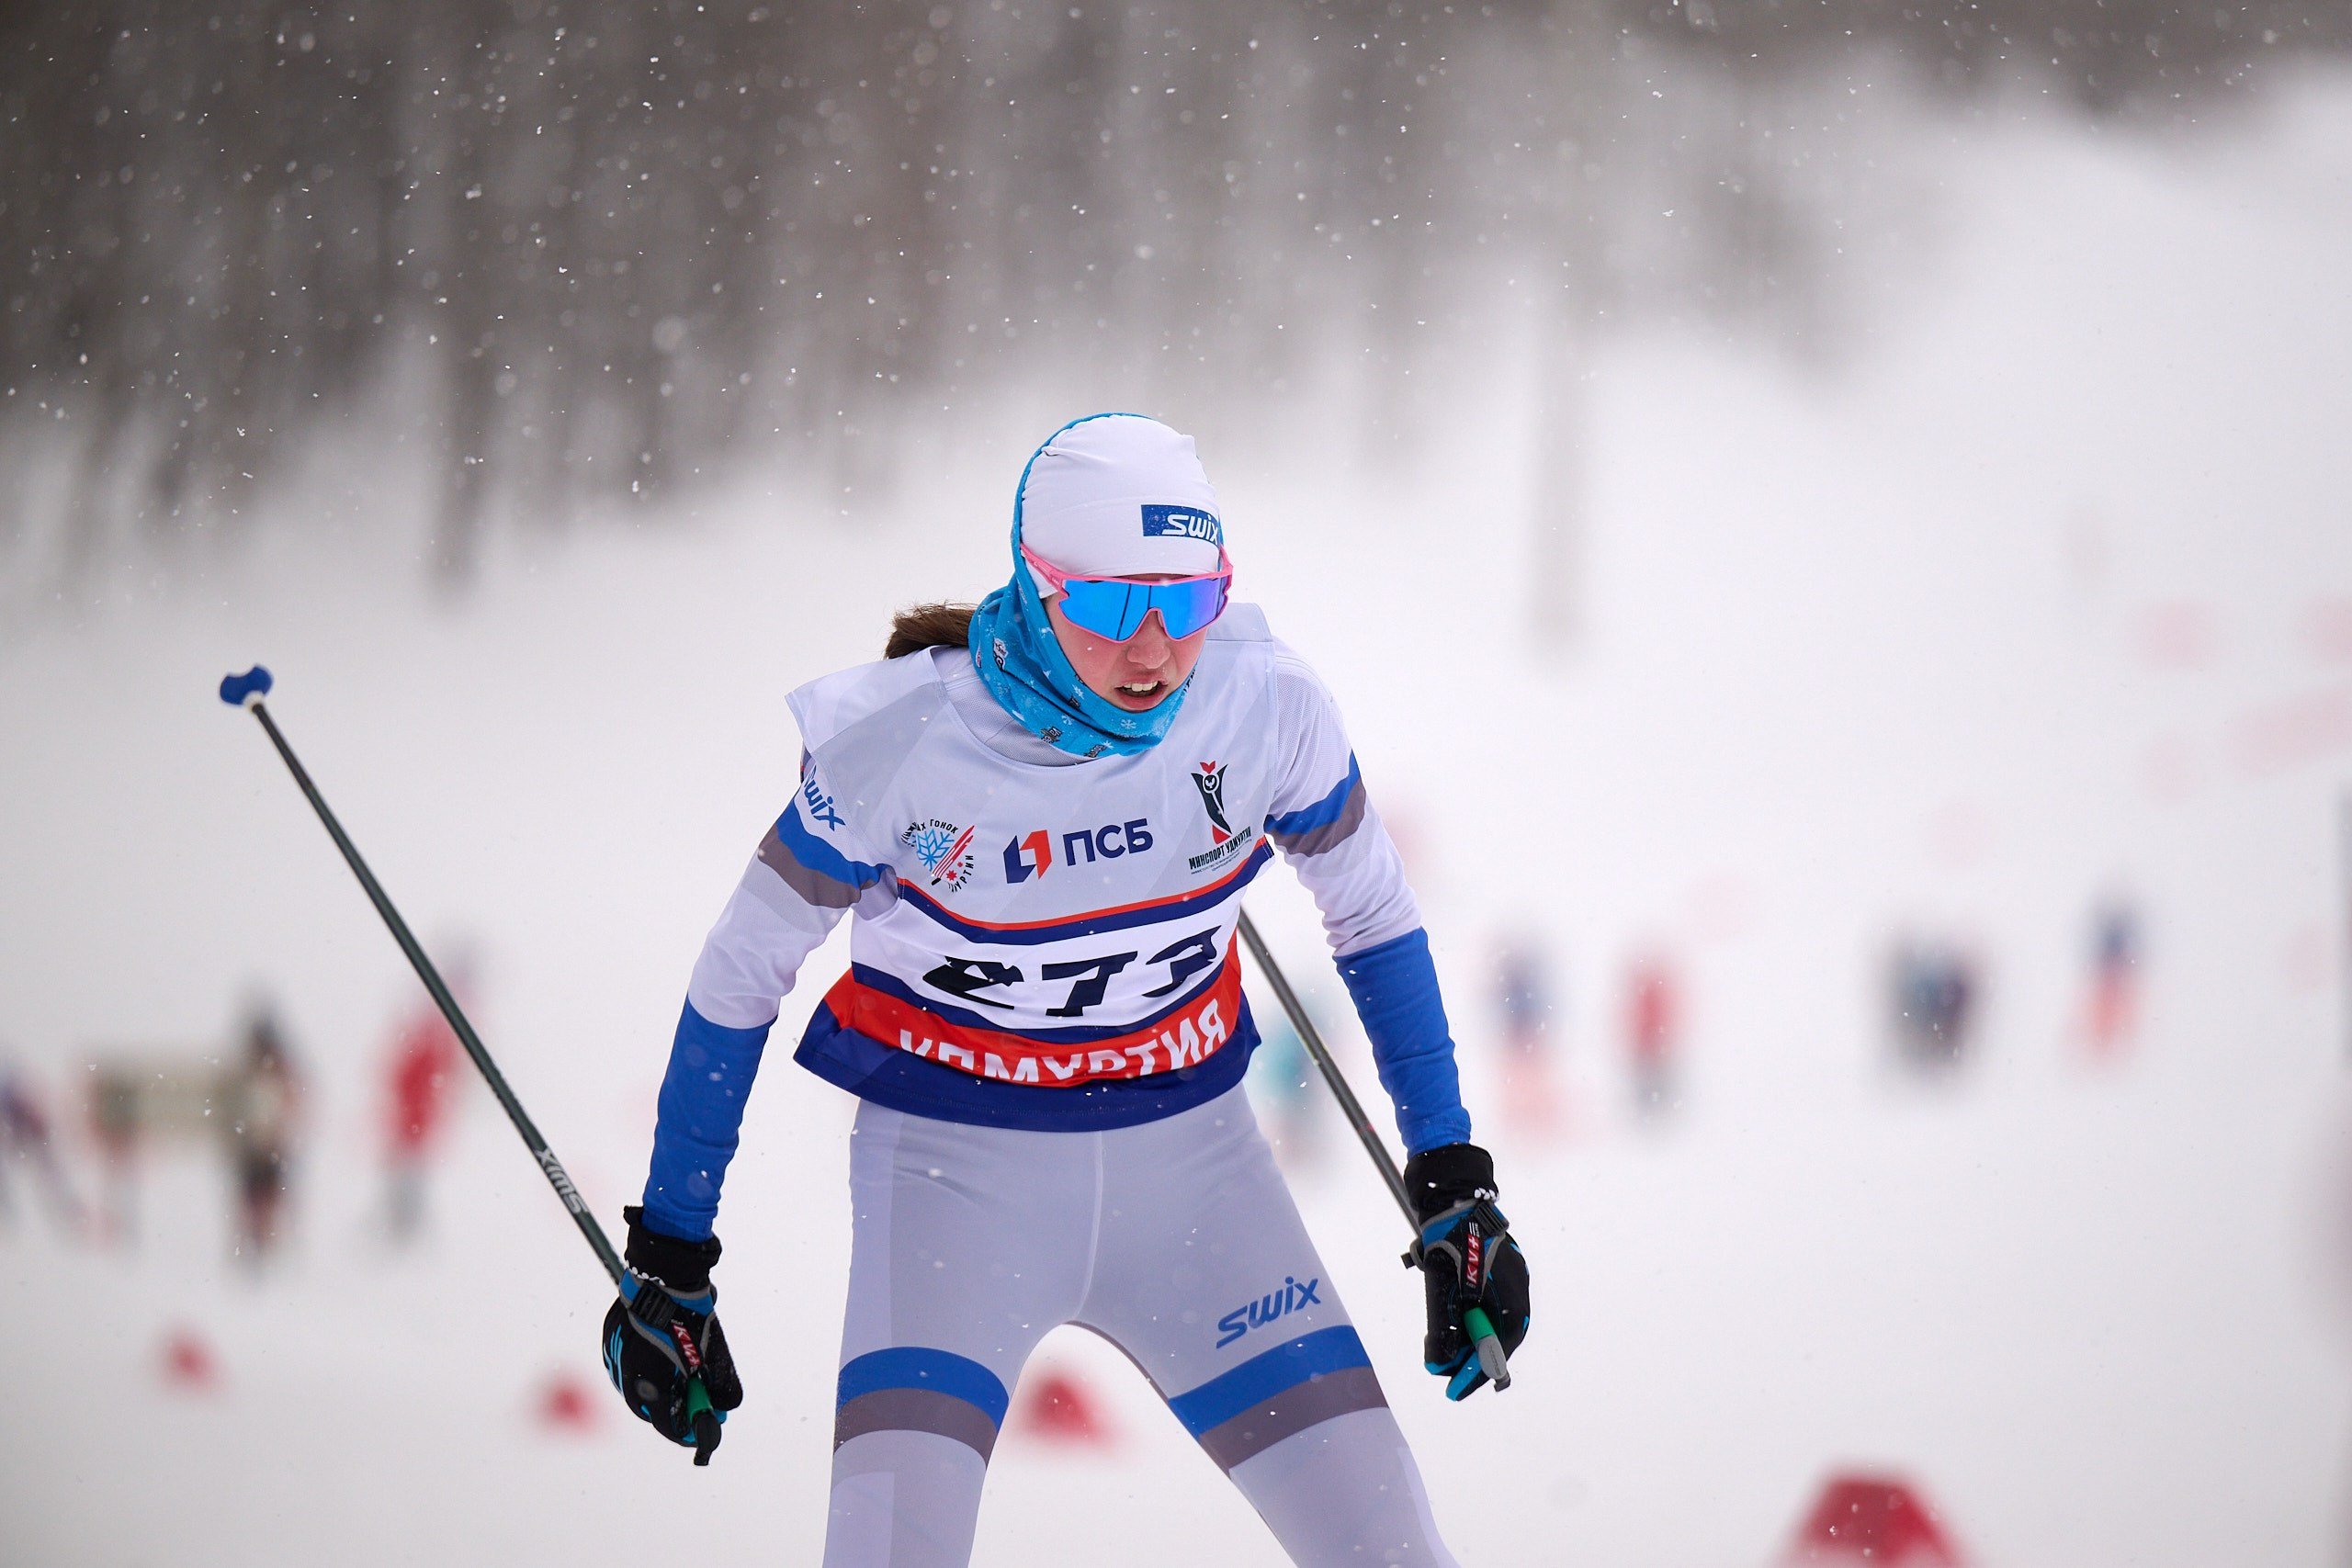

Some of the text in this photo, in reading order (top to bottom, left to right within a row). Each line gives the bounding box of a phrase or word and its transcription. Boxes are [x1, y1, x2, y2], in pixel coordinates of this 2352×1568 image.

[930, 818, 958, 834] ГОНОК
[1062, 818, 1154, 866] ПСБ
[1188, 846, 1225, 870] МИНСПОРТ
